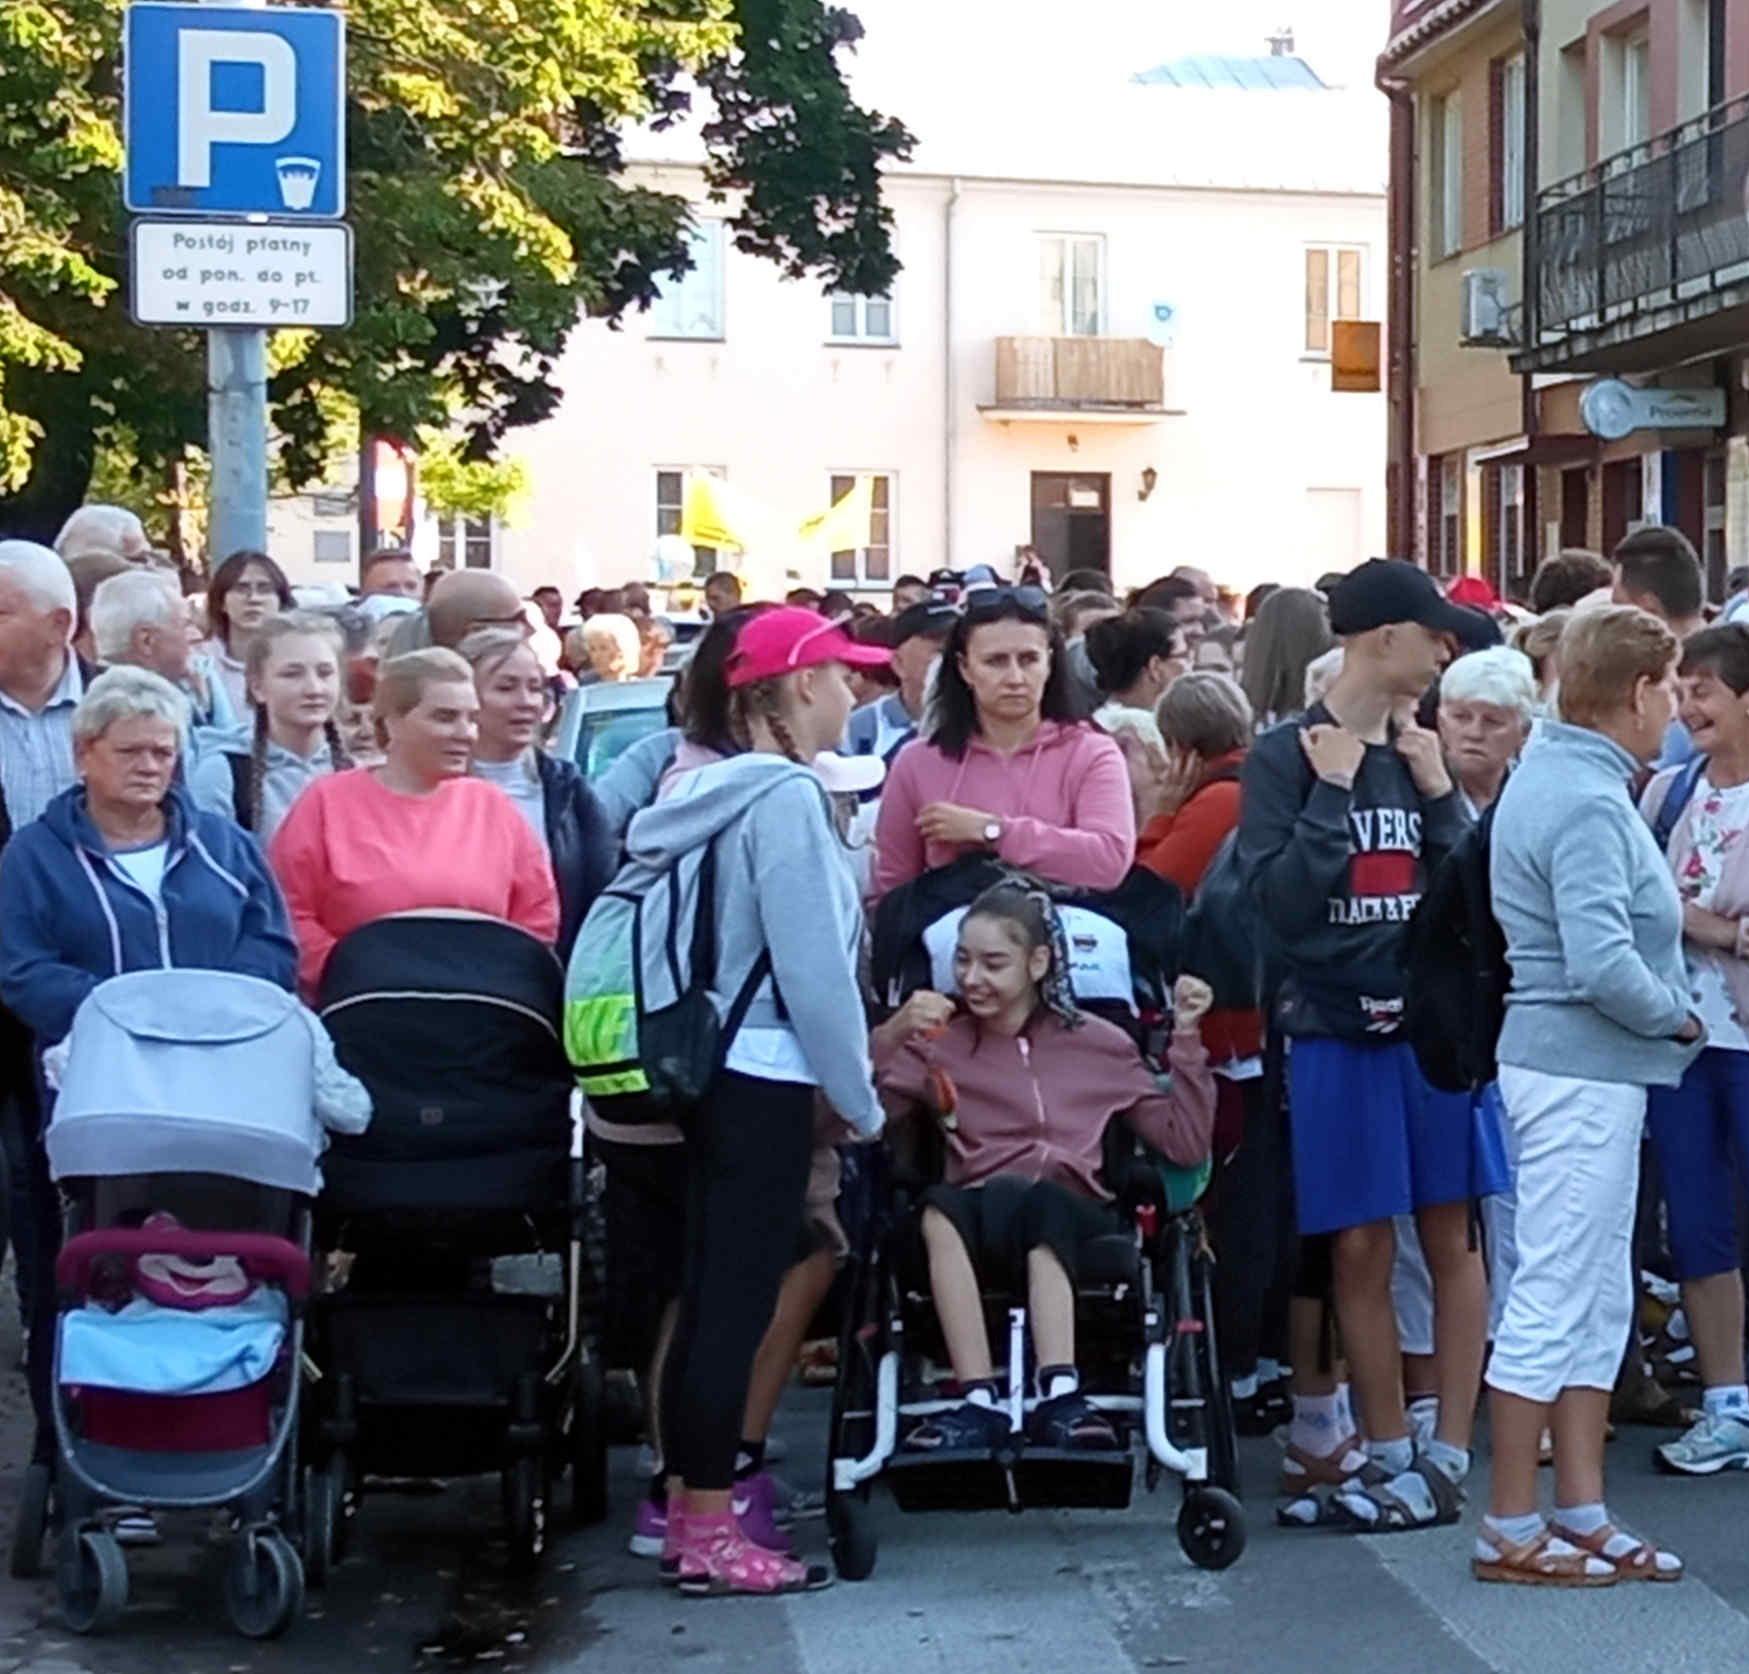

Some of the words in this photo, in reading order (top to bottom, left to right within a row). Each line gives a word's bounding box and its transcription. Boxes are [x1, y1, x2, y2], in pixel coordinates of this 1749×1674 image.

[178, 28, 297, 188] P
[173, 233, 234, 253] Postój
[246, 236, 311, 257] płatny
[162, 267, 188, 281] od
[200, 268, 245, 285] pon.
[257, 268, 283, 283] do
[294, 270, 320, 287] pt.
[176, 301, 190, 312] w
[202, 299, 256, 317] godz.
[269, 298, 310, 314] 9-17
[1349, 808, 1423, 857] VERS
